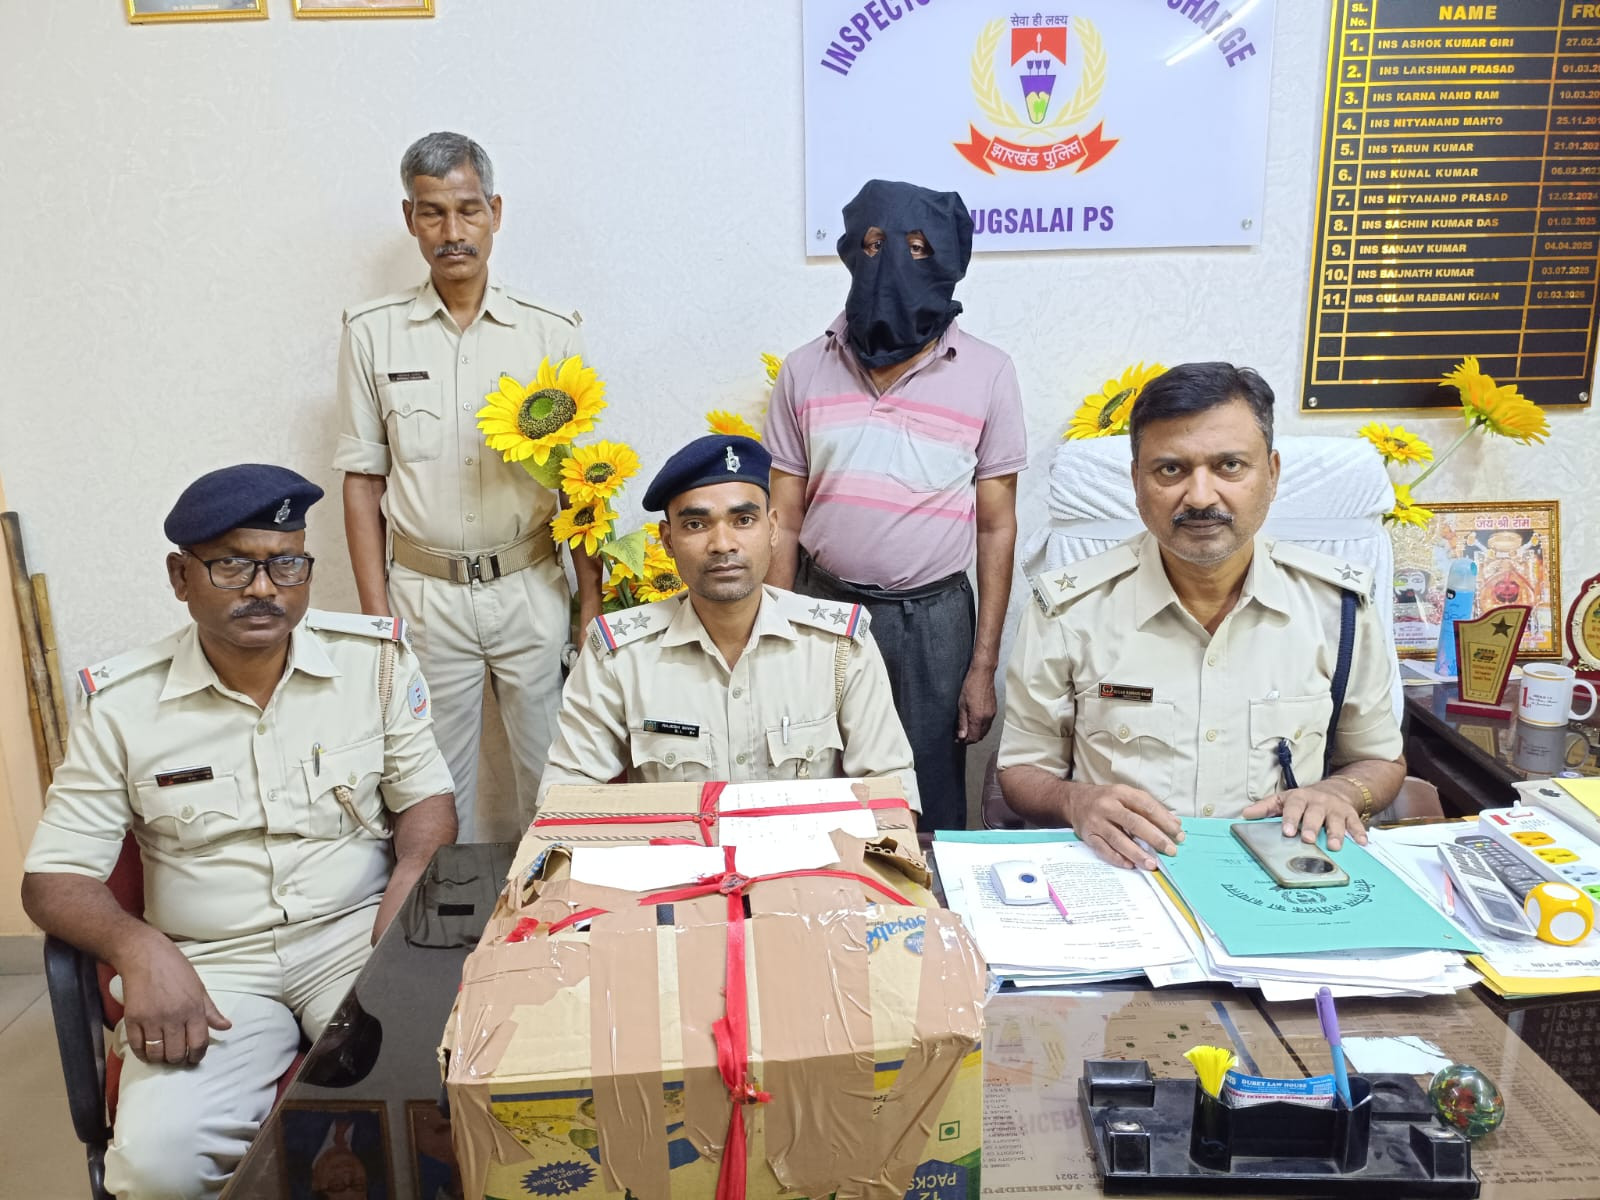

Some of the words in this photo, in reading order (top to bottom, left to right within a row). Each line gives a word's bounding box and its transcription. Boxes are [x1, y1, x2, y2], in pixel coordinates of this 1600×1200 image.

[1351, 4, 1368, 13] SL.
[1439, 5, 1497, 21] NAME
[1010, 12, 1029, 27] सेवा
[1032, 12, 1042, 27] ही
[1045, 14, 1068, 26] लक्ष्य
[1350, 17, 1367, 27] No.
[820, 0, 930, 76] INSPEC
[1350, 38, 1364, 52] 1.
[1378, 39, 1398, 49] INS
[1401, 39, 1442, 49] ASHOK
[1445, 38, 1487, 48] KUMAR
[1489, 37, 1515, 48] GIRI
[1346, 65, 1362, 79] 2.
[1379, 66, 1400, 76] INS
[1403, 65, 1467, 75] LAKSHMAN
[1470, 64, 1515, 74] PRASAD
[1344, 92, 1359, 105] 3.
[1372, 93, 1393, 102] INS
[1396, 92, 1436, 101] KARNA
[1439, 91, 1472, 100] NAND
[1475, 90, 1500, 100] RAM
[1342, 118, 1357, 131] 4.
[1370, 118, 1390, 128] INS
[1393, 117, 1460, 128] NITYANAND
[1463, 116, 1503, 126] MAHTO
[990, 142, 1039, 167] झारखंड
[1043, 140, 1081, 169] पुलिस
[1340, 143, 1354, 156] 5.
[1368, 144, 1388, 153] INS
[1391, 143, 1429, 153] TARUN
[1433, 142, 1474, 152] KUMAR
[1338, 168, 1353, 182] 6.
[1365, 169, 1386, 179] INS
[1390, 168, 1431, 179] KUNAL
[1435, 167, 1479, 178] KUMAR
[1336, 194, 1350, 207] 7.
[1363, 194, 1384, 204] INS
[1387, 193, 1457, 204] NITYANAND
[1461, 192, 1509, 202] PRASAD
[970, 207, 1074, 235] UGSALAI
[1083, 205, 1114, 232] PS
[1333, 219, 1348, 232] 8.
[1361, 220, 1382, 230] INS
[1385, 218, 1428, 229] SACHIN
[1431, 218, 1474, 228] KUMAR
[1476, 217, 1499, 228] DAS
[1331, 244, 1346, 257] 9.
[1359, 245, 1379, 255] INS
[1381, 244, 1424, 254] SANJAY
[1426, 243, 1467, 253] KUMAR
[1325, 268, 1348, 281] 10.
[1357, 269, 1377, 279] INS
[1435, 267, 1475, 278] KUMAR
[1323, 293, 1346, 306] 11.
[1354, 294, 1374, 304] INS
[1375, 292, 1415, 303] GULAM
[1417, 292, 1465, 302] RABBANI
[1468, 291, 1500, 301] KHAN
[1475, 516, 1493, 529] जय
[1497, 516, 1509, 529] श्री
[1512, 516, 1531, 529] राम
[1241, 1079, 1266, 1087] DUBEY
[558, 1168, 584, 1179] Super
[532, 1176, 557, 1187] Value
[554, 1180, 572, 1190] 12
[982, 1183, 1084, 1195] JAMSHEDPU
